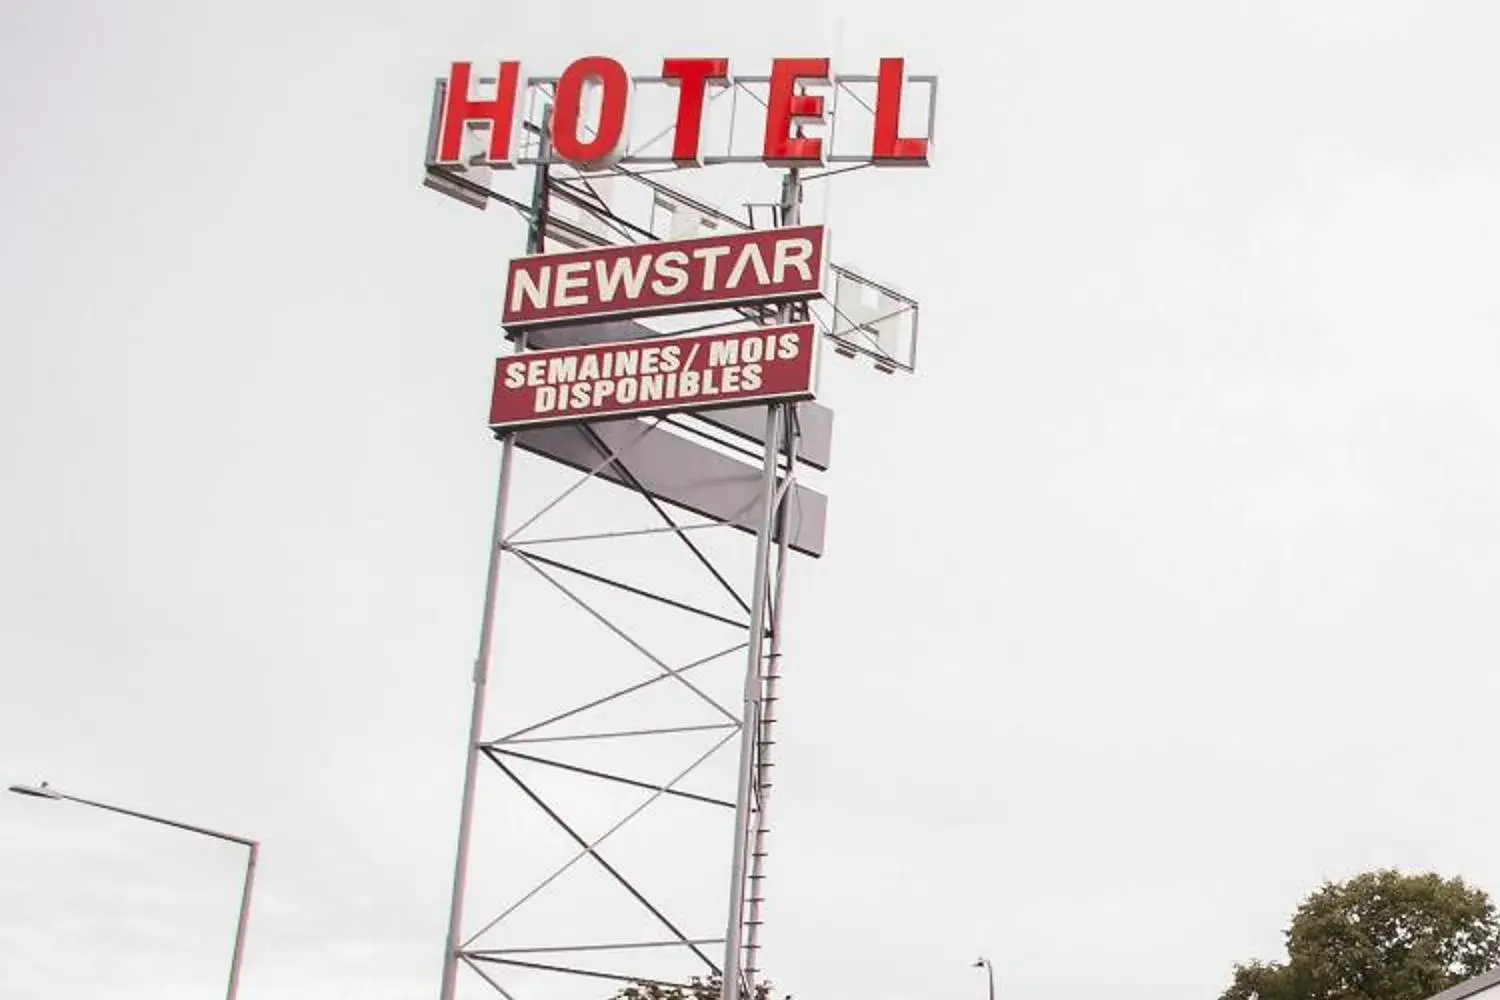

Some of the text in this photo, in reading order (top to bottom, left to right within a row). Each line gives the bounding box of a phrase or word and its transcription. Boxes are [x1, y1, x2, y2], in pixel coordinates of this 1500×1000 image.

[438, 56, 931, 168] HOTEL
[510, 237, 813, 311] NEWSTAR
[709, 333, 800, 367] MOIS
[534, 364, 763, 413] DISPONIBLES
